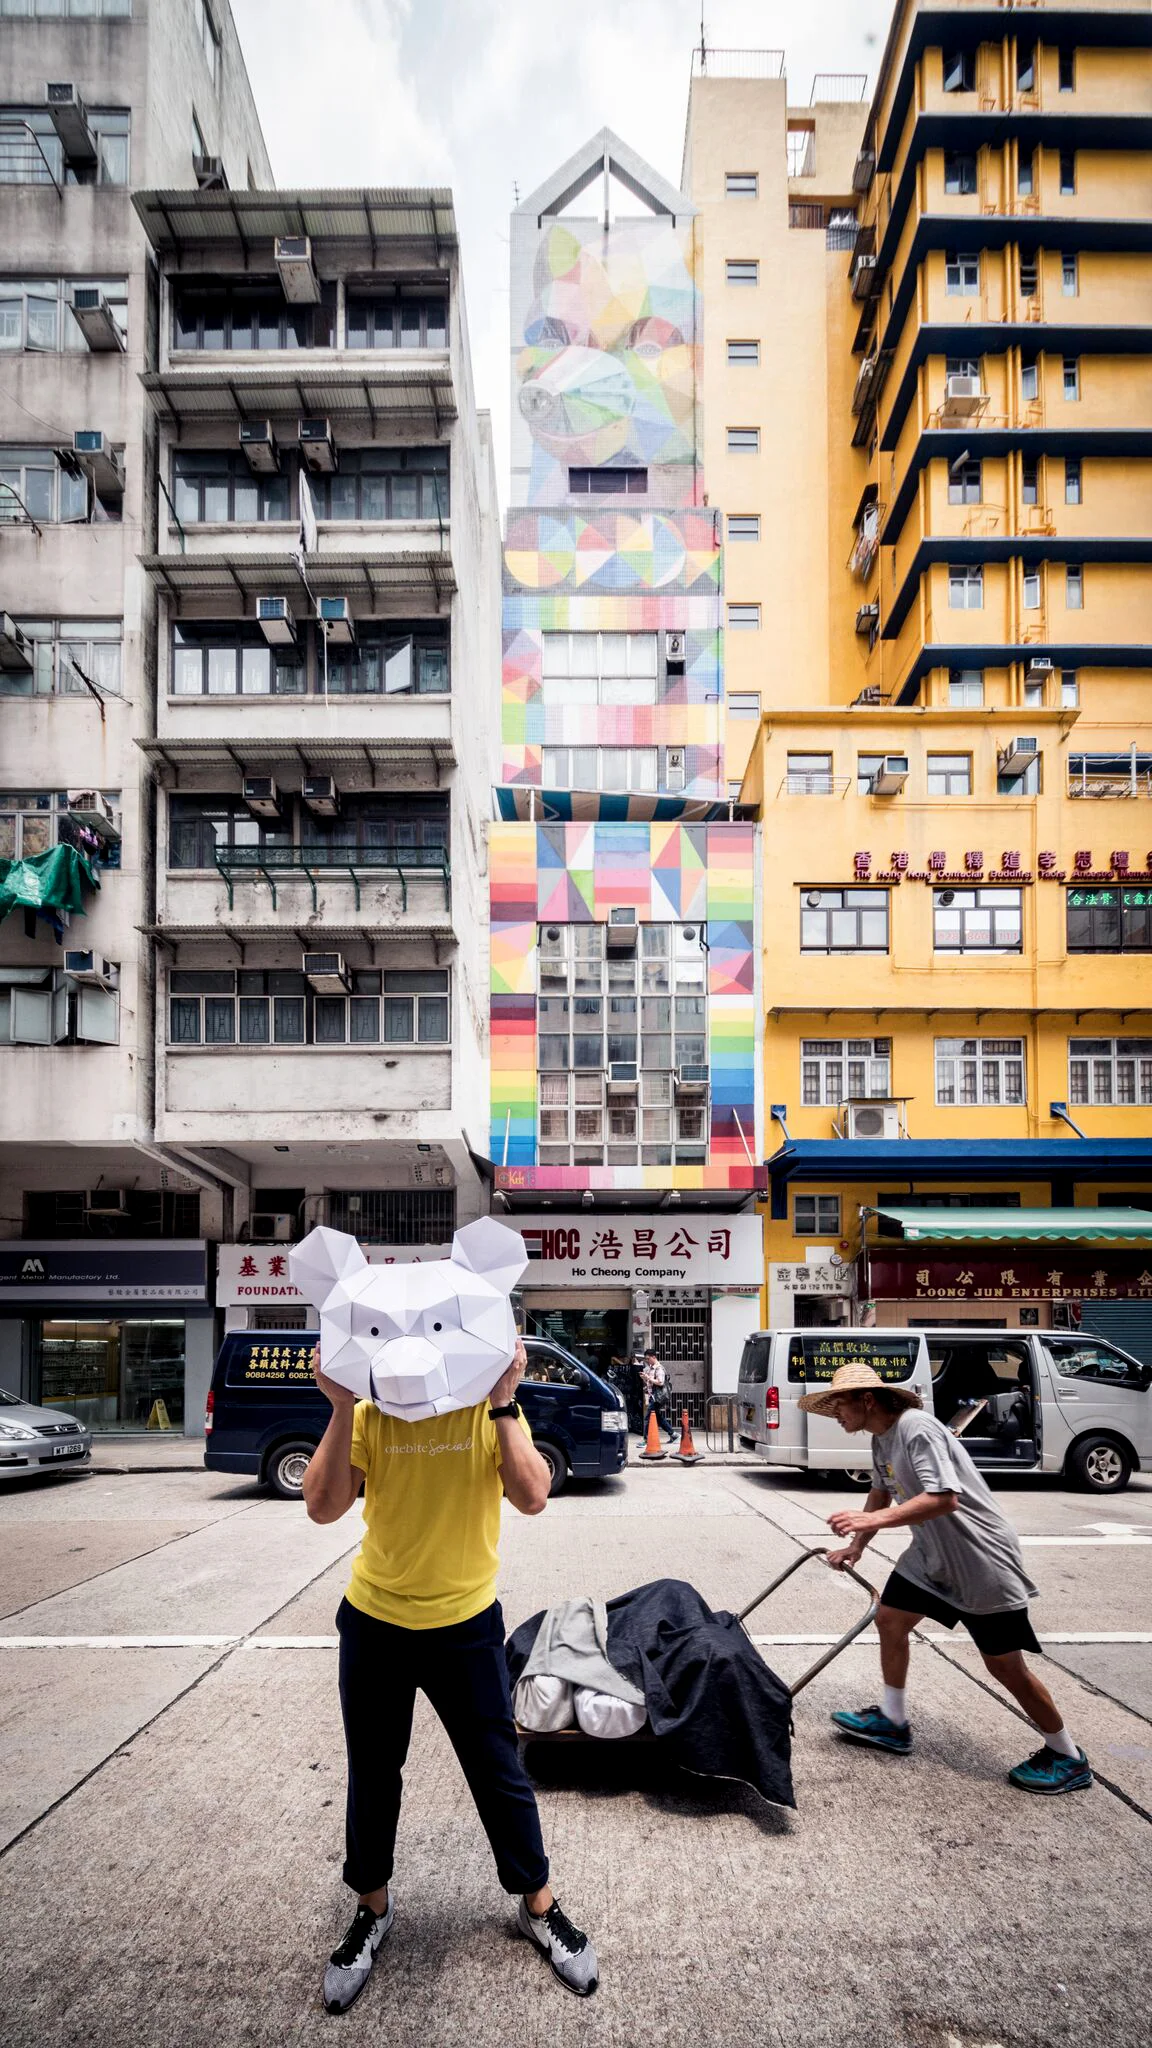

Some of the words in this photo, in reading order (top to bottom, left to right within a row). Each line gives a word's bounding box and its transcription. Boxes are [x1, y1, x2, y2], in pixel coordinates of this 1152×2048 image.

[854, 850, 1152, 870] 香港儒釋道孝思壇
[855, 869, 872, 878] The
[877, 870, 902, 880] Hong
[907, 870, 932, 880] Kong
[937, 870, 983, 878] Confucian
[990, 870, 1033, 878] Buddhist
[542, 1228, 580, 1260] HCC
[589, 1227, 732, 1260] 浩昌公司
[571, 1267, 587, 1277] Ho
[591, 1267, 631, 1278] Cheong
[635, 1267, 686, 1279] Company
[237, 1286, 304, 1296] FOUNDATI
[916, 1287, 967, 1297] LOONG
[974, 1287, 1004, 1297] JUN
[1011, 1287, 1118, 1297] ENTERPRISES
[245, 1371, 286, 1379] 90884256
